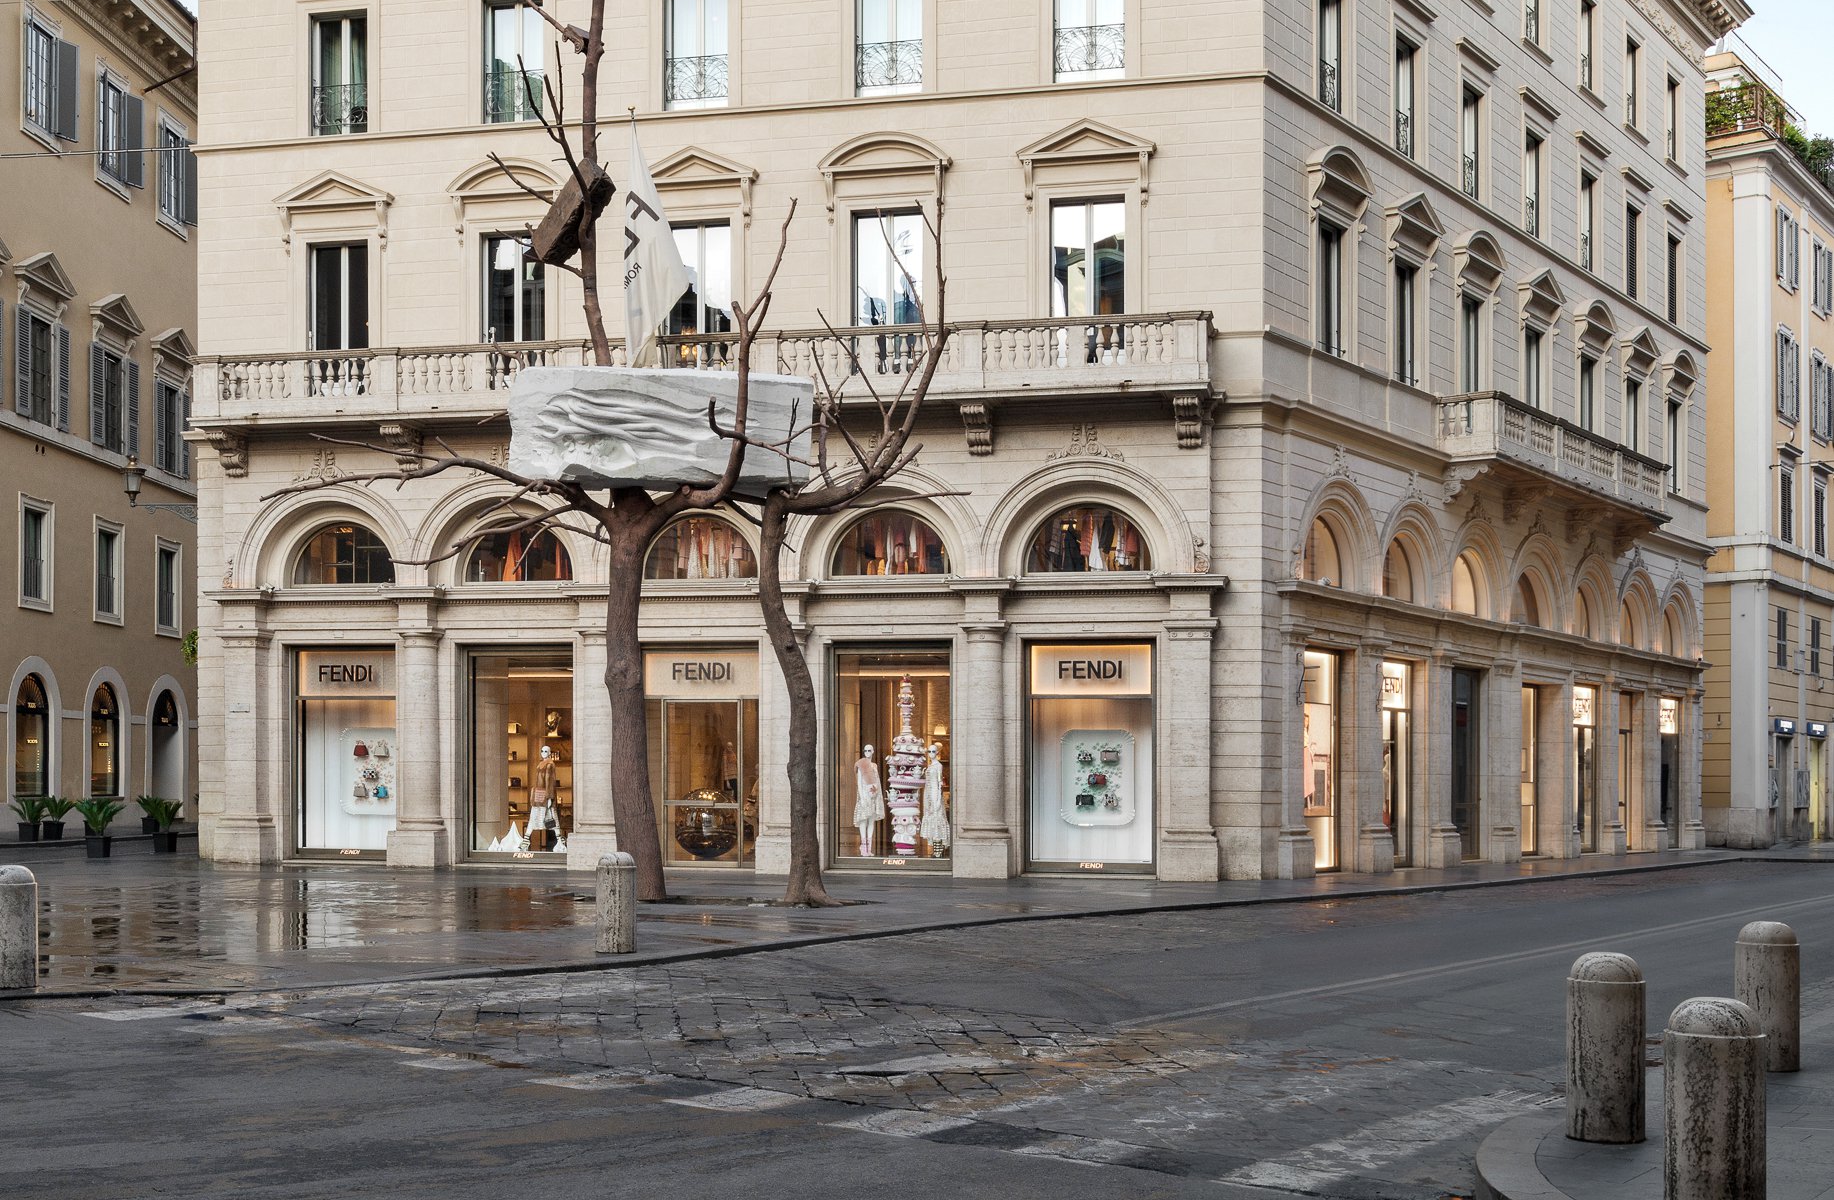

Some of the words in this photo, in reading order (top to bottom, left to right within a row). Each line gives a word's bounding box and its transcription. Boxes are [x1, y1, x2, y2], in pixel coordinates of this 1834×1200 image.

[319, 665, 372, 682] FENDI
[672, 662, 731, 681] FENDI
[1058, 660, 1123, 679] FENDI
